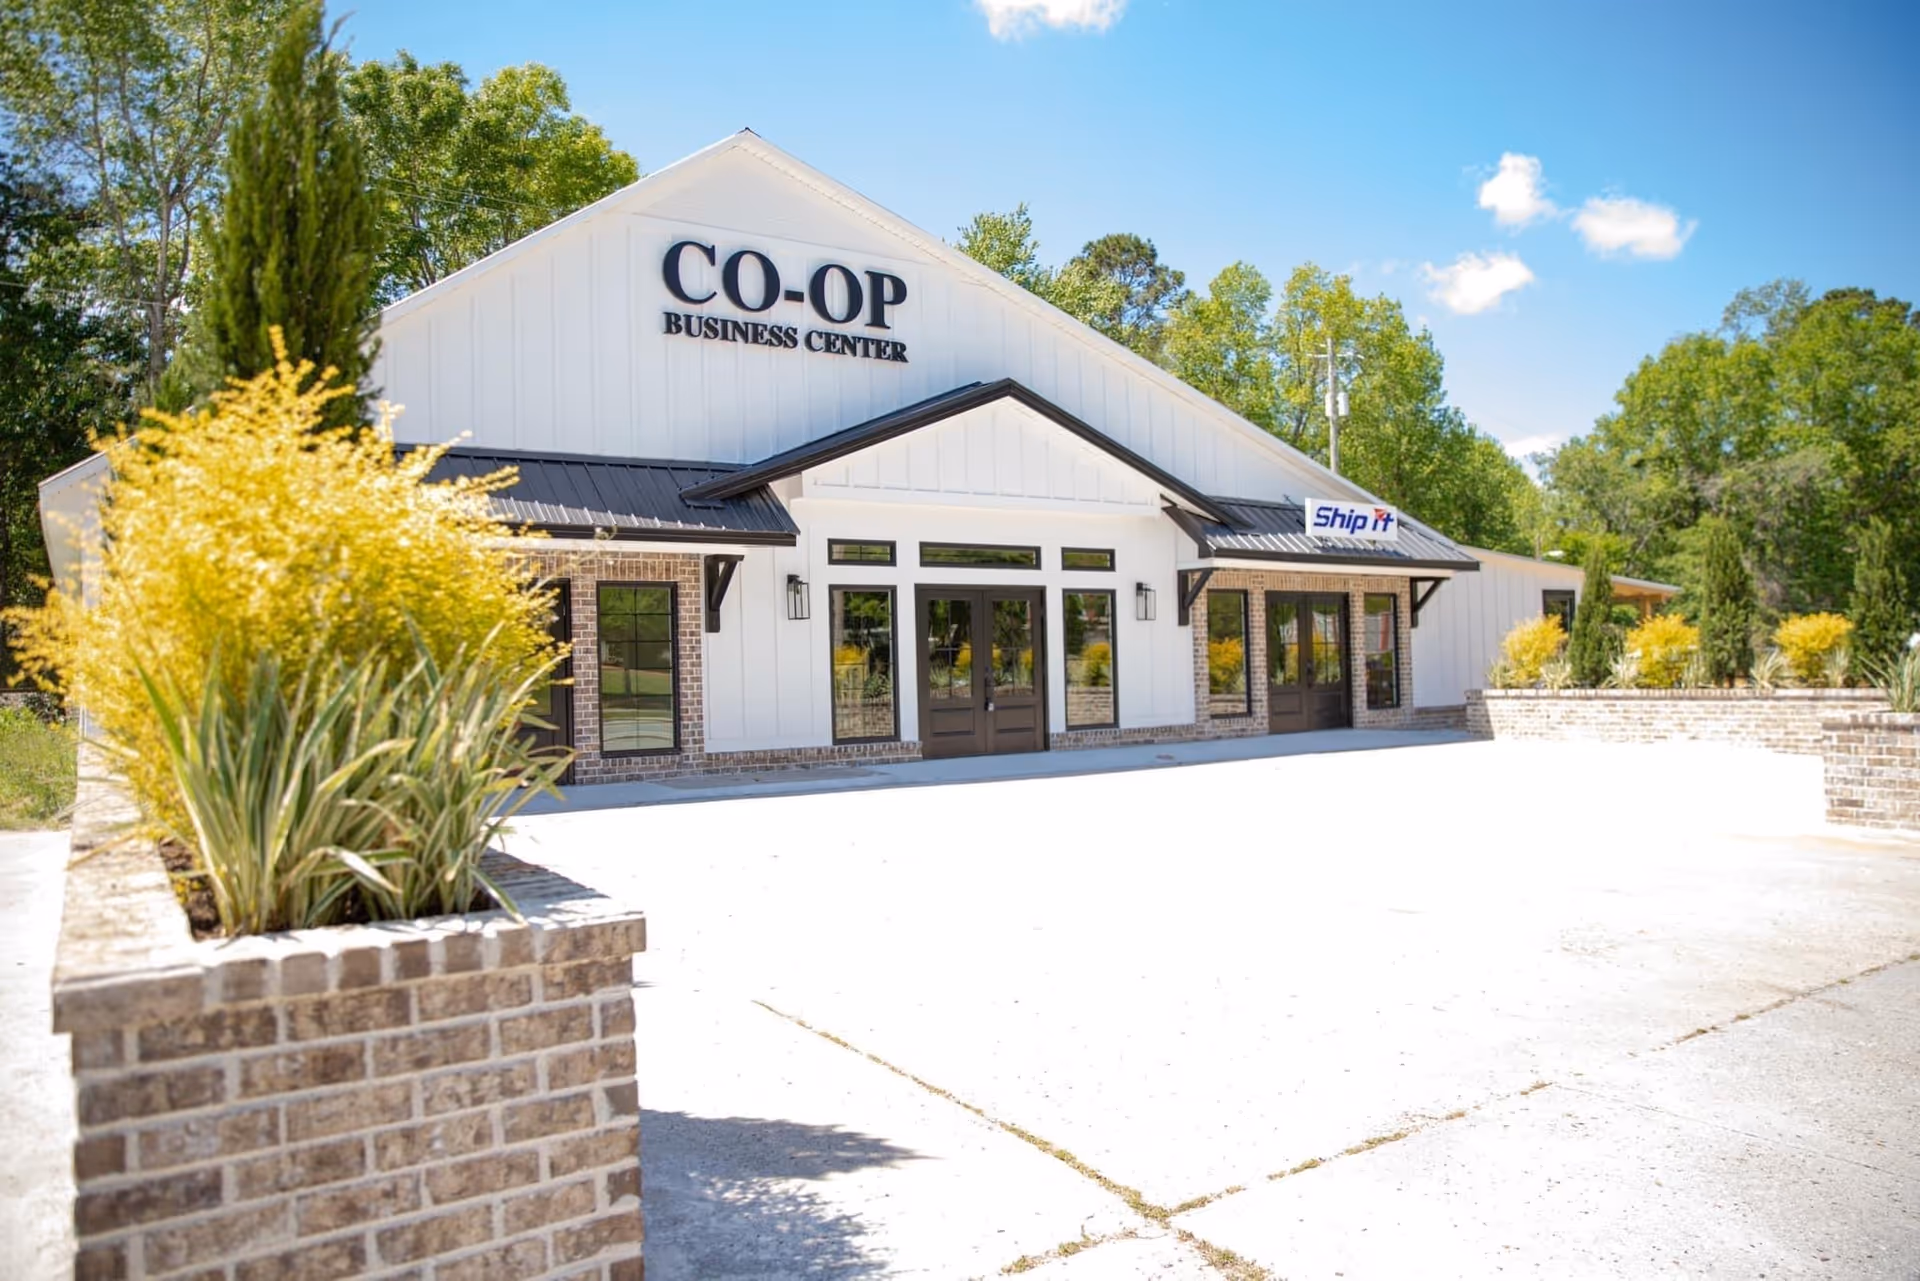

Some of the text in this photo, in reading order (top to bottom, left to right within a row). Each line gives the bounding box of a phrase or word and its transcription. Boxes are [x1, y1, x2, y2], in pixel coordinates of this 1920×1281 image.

[662, 240, 907, 329] CO-OP
[662, 312, 909, 363] BUSINESS CENTER
[1313, 506, 1368, 534] Ship
